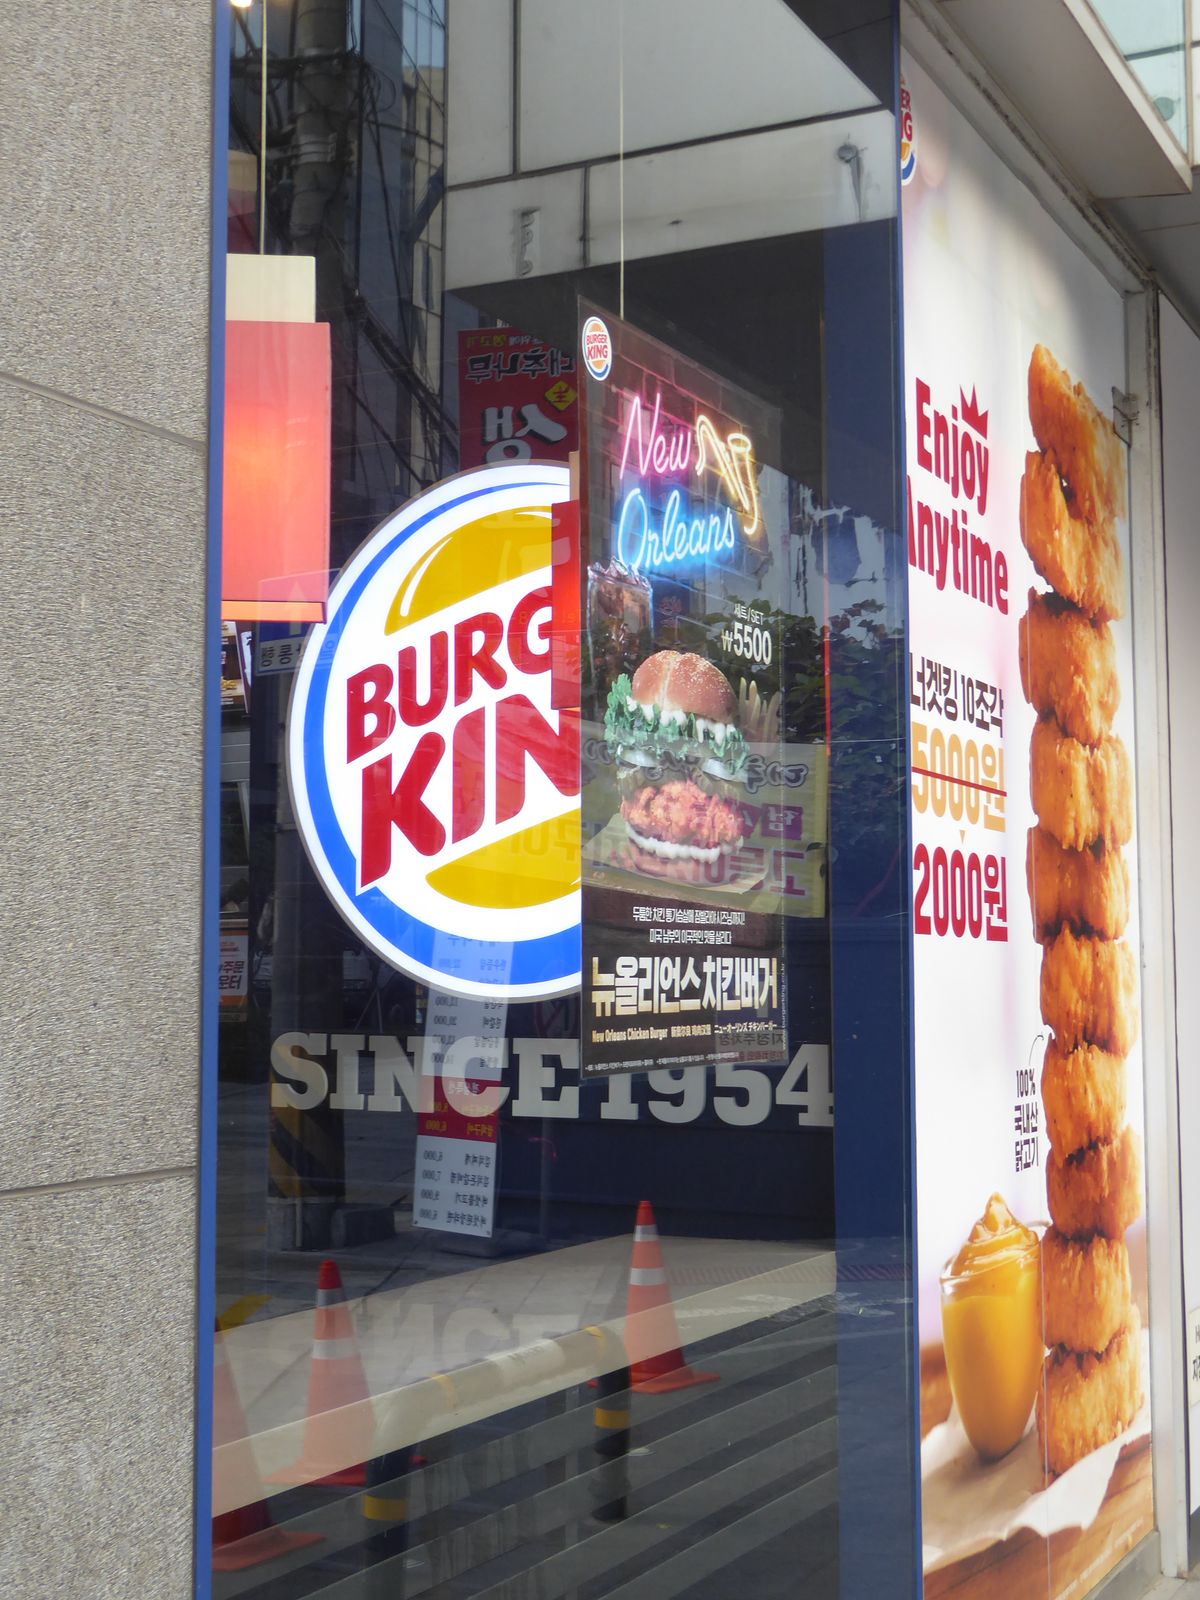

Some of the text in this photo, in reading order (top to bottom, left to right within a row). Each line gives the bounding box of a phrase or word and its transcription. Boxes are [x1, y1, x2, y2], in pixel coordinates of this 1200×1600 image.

[586, 331, 609, 348] BURGER
[587, 344, 609, 361] KING
[620, 392, 692, 481] New
[916, 377, 989, 516] Enjoy
[618, 487, 736, 569] Orleans
[910, 652, 1004, 738] 너겟킹 10조각
[911, 721, 1006, 833] 5000원
[914, 843, 1008, 942] 2000원
[592, 1025, 668, 1043] New Orleans Chicken Burger
[270, 1031, 834, 1127] SINCE 1954
[1014, 1102, 1038, 1135] 국내산
[1016, 1067, 1036, 1098] 100%
[1015, 1136, 1039, 1173] 닭고기
